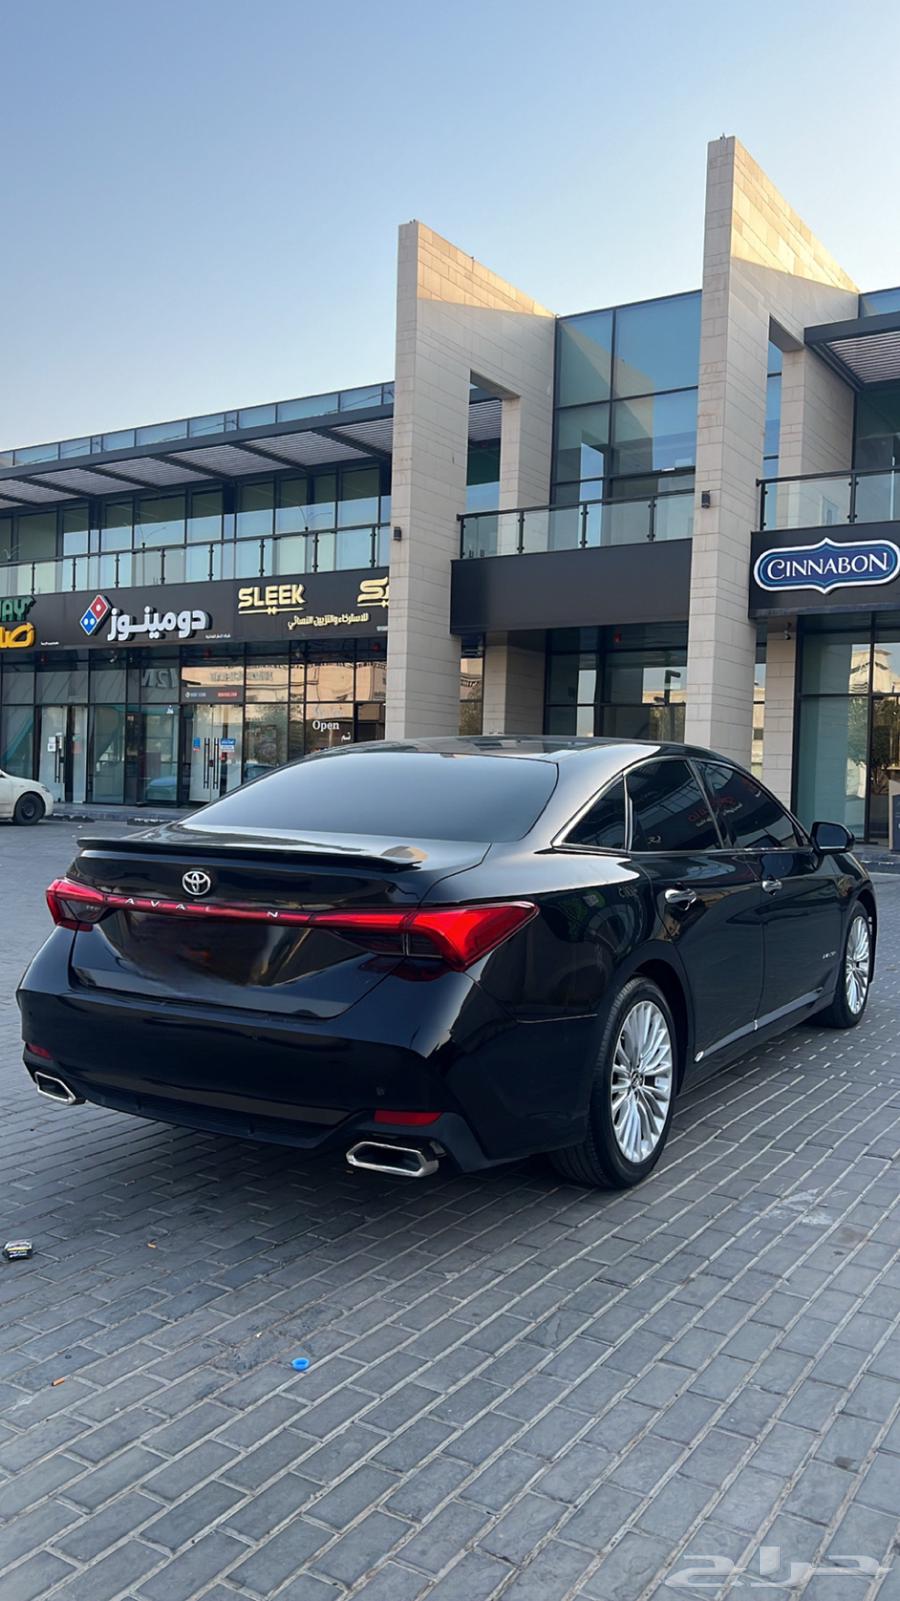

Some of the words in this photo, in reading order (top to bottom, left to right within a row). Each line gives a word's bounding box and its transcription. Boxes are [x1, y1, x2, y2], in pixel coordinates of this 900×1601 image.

[767, 552, 888, 580] CINNABON
[238, 583, 306, 608] SLEEK
[0, 596, 36, 622] AY
[107, 605, 207, 641] دومينوز
[312, 719, 340, 733] Open
[125, 897, 279, 919] AVAN
